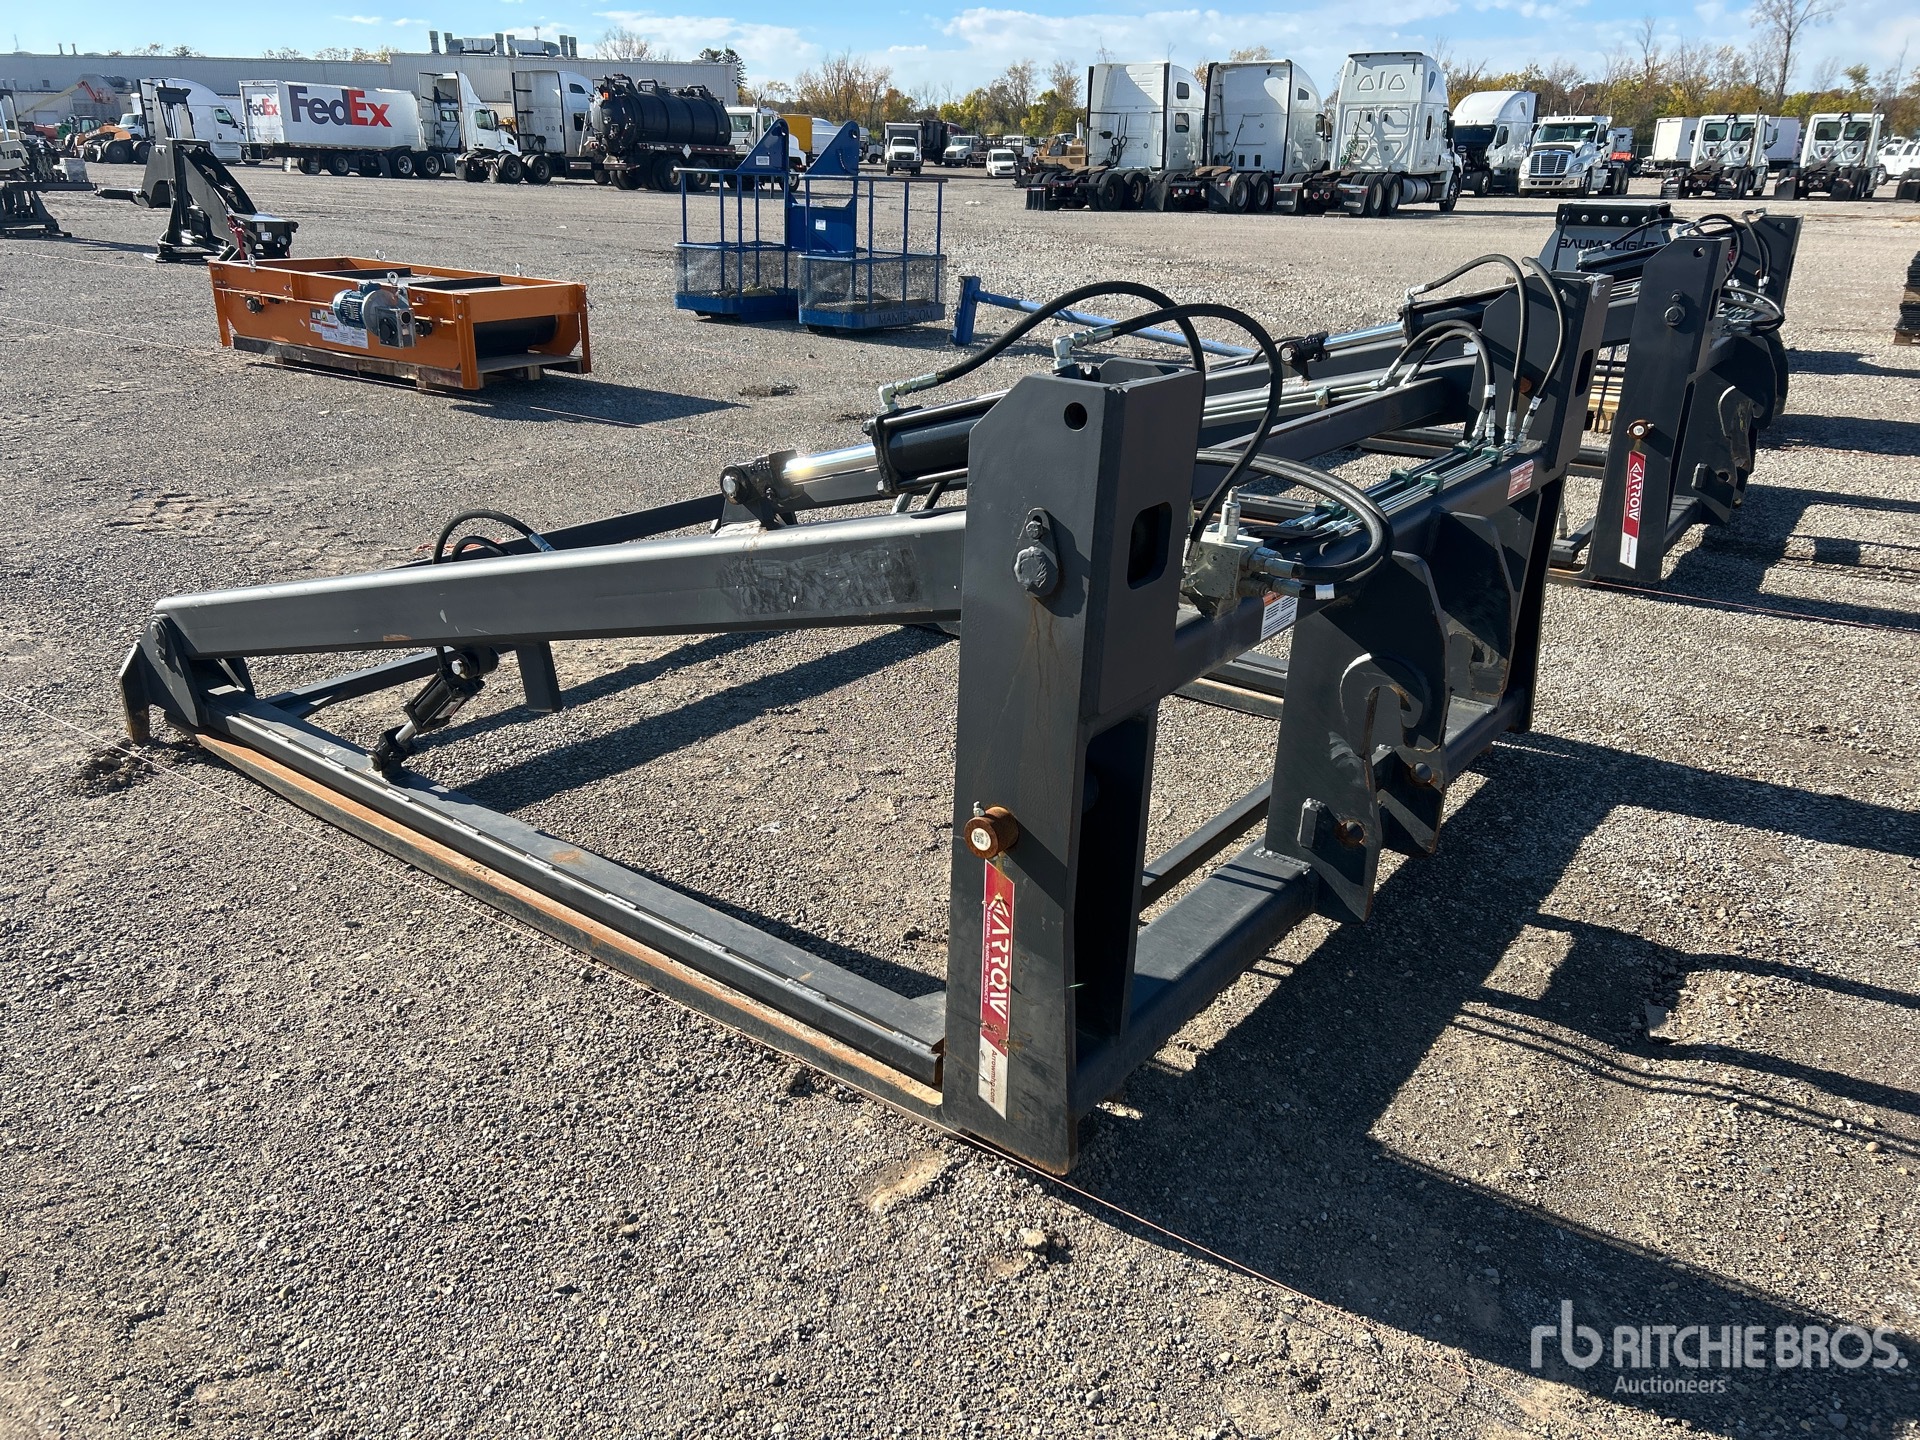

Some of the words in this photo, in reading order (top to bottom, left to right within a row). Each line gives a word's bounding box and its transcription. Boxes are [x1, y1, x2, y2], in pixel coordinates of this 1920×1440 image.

[246, 98, 279, 116] FedEx
[288, 84, 393, 128] FedEx
[1629, 473, 1642, 521] ARROW
[990, 914, 1010, 1021] ARROW
